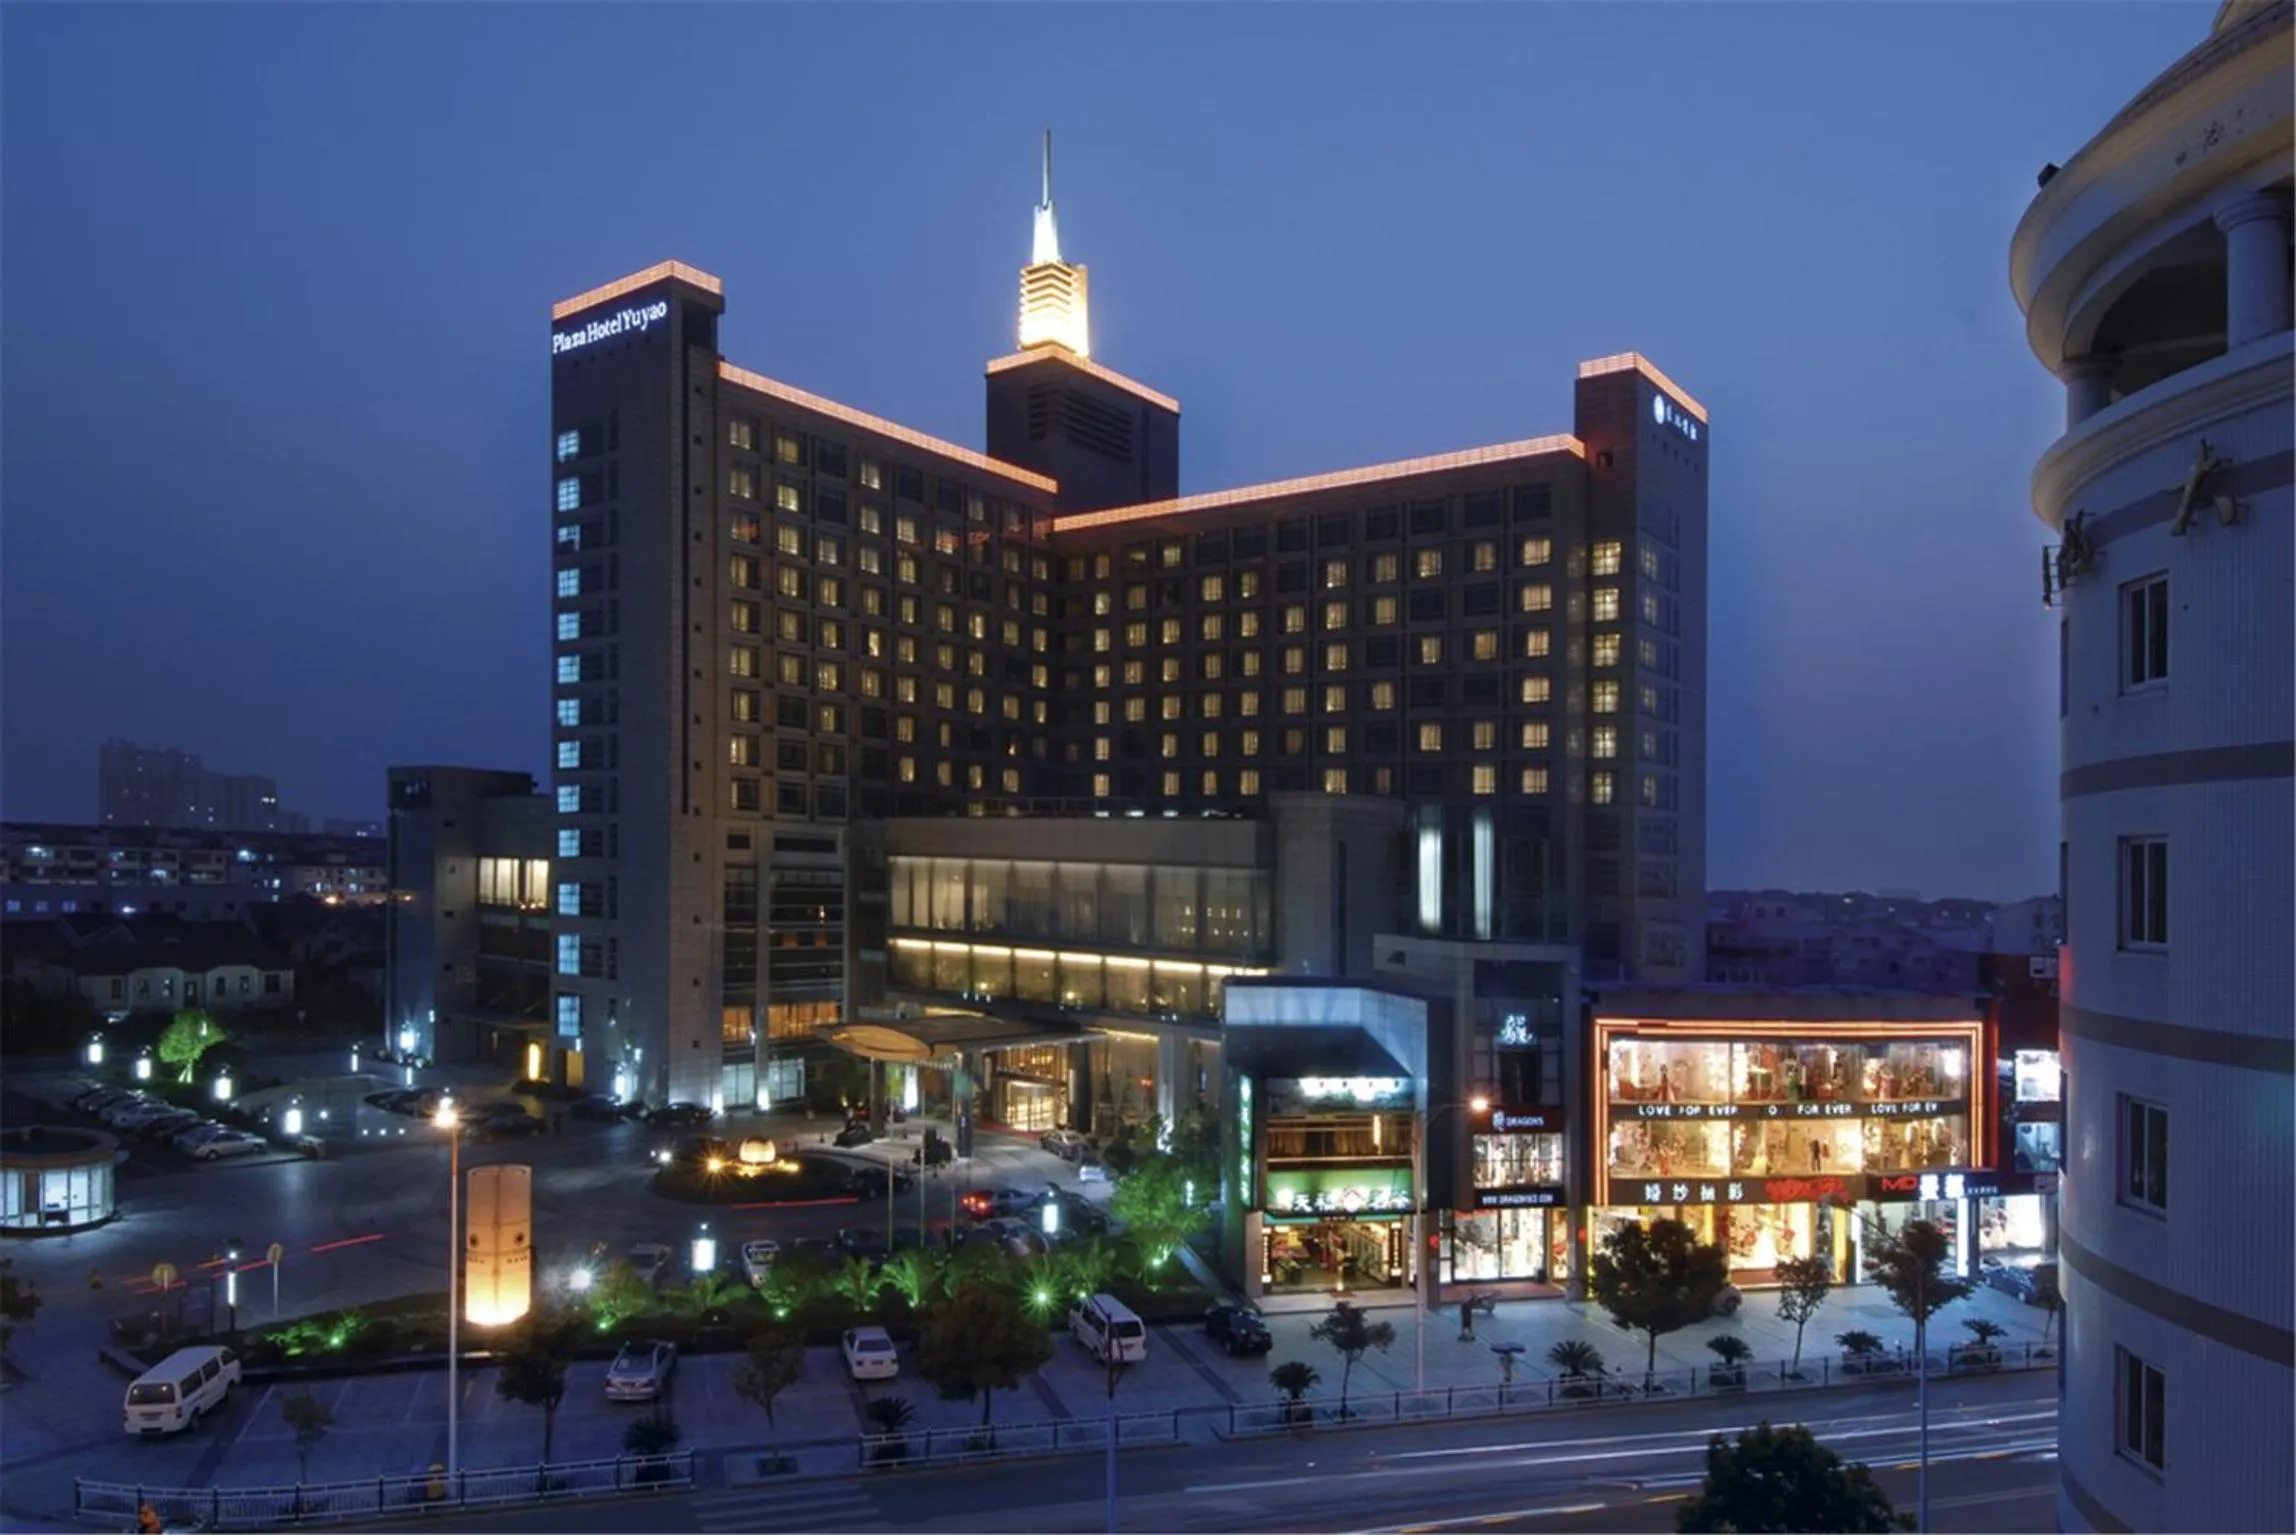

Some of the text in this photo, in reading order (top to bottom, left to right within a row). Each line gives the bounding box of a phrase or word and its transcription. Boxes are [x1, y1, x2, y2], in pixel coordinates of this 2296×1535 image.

[552, 301, 668, 354] Plaza Hotel Yuyao
[1638, 1104, 1671, 1116] LOVE
[1797, 1103, 1819, 1115] FOR
[1825, 1103, 1853, 1115] EVER
[1871, 1103, 1898, 1115] LOVE
[1902, 1101, 1921, 1113] FOR
